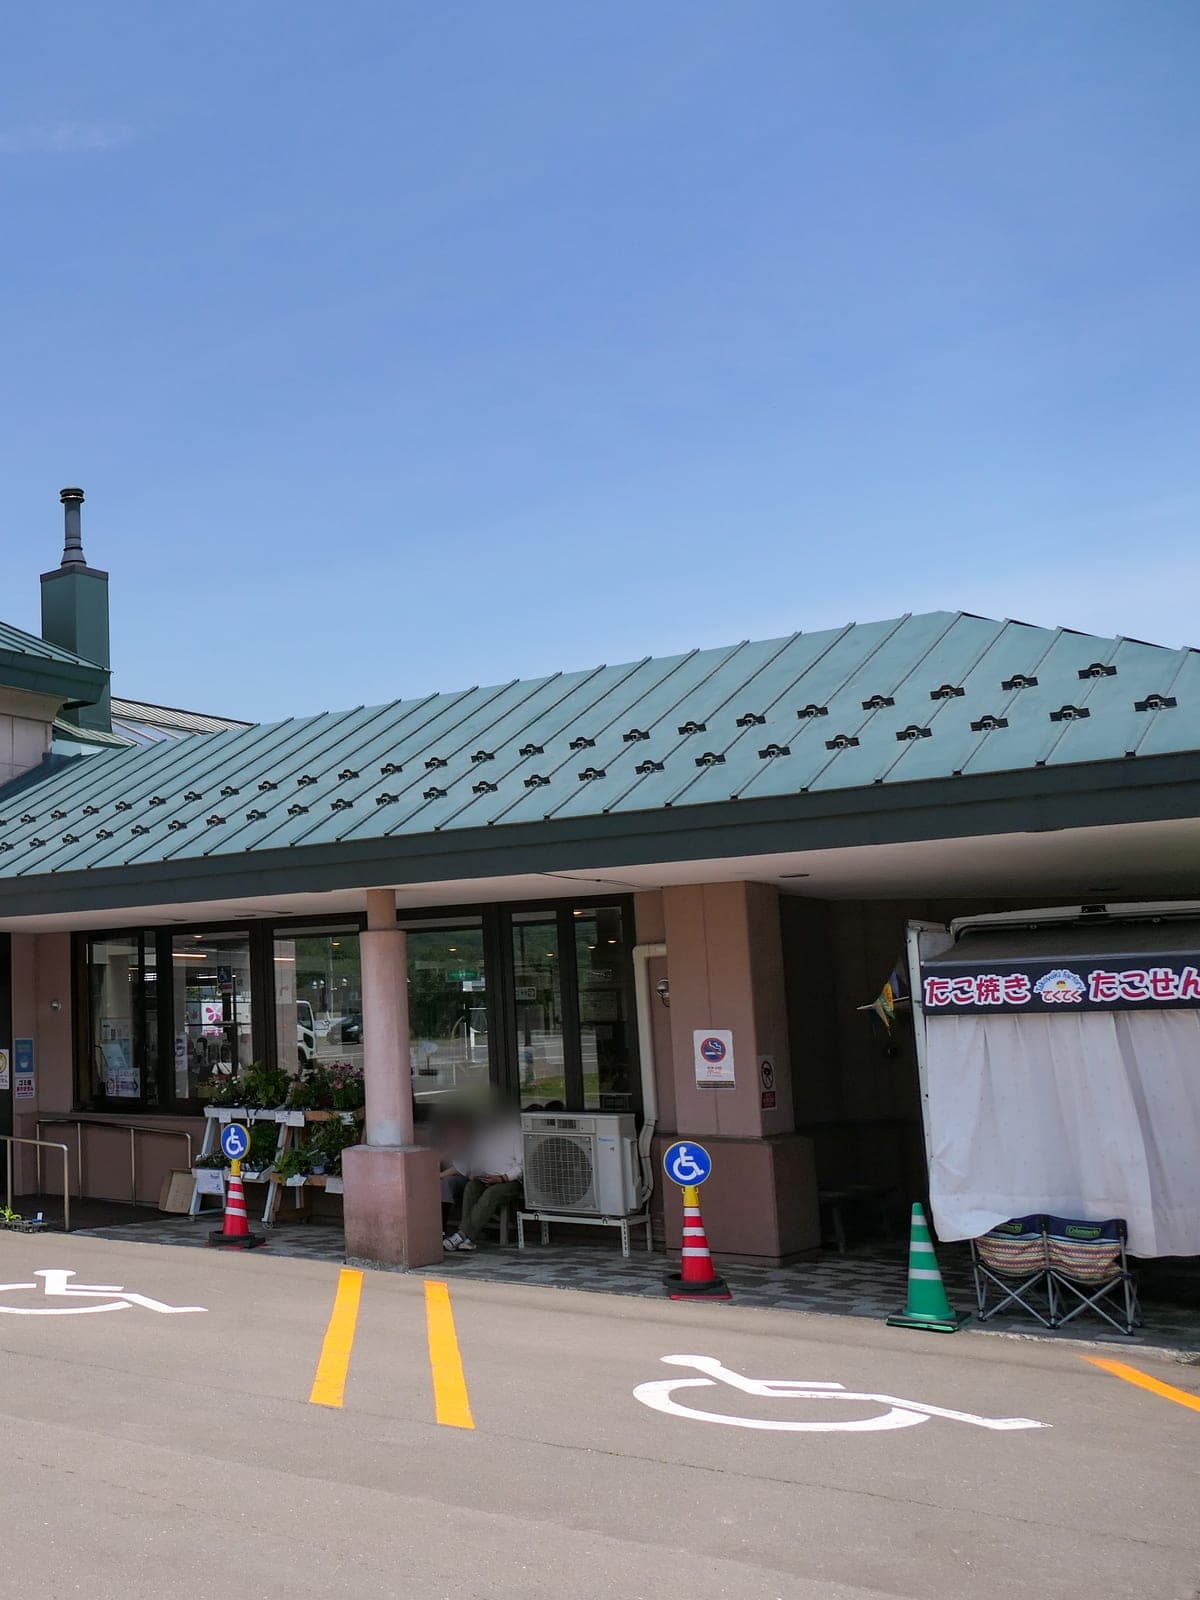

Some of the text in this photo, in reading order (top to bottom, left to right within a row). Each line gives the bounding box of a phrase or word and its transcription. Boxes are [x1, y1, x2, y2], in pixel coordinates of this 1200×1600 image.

[924, 974, 1031, 1006] たこ焼き
[1042, 990, 1081, 1002] てくてく
